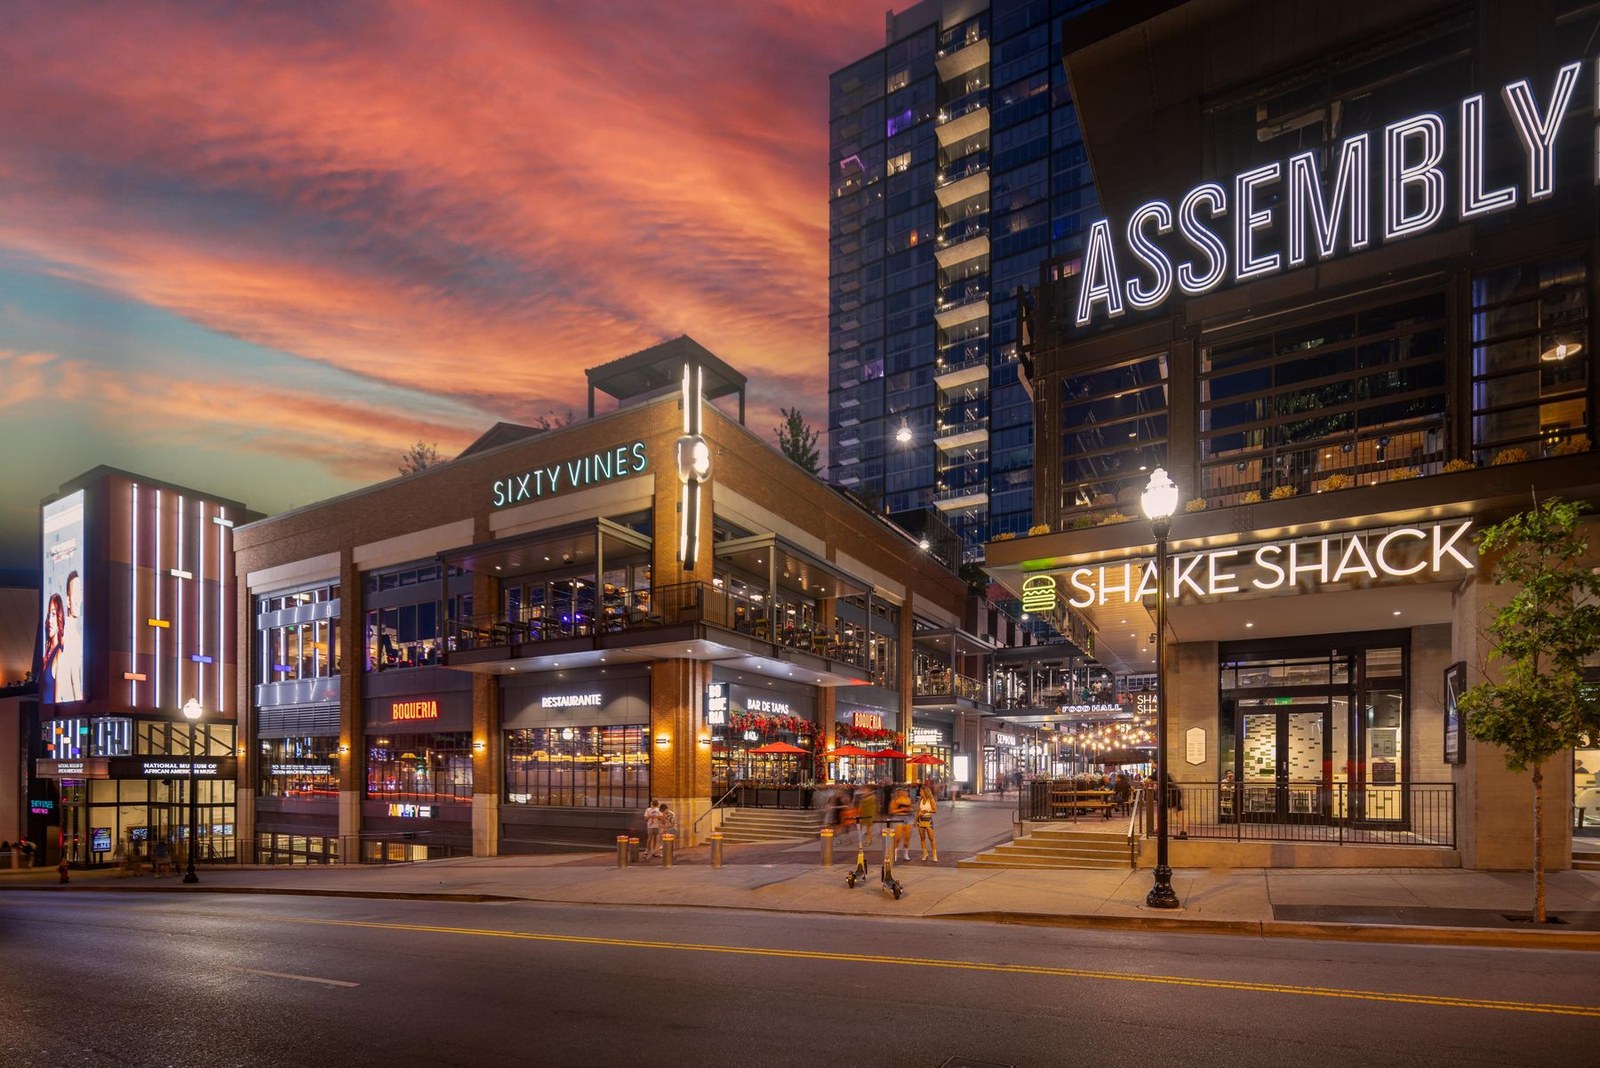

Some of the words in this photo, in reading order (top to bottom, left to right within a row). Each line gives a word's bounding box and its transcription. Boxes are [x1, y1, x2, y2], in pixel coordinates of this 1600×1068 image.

[1076, 61, 1582, 326] ASSEMBLY
[493, 464, 561, 507] SIXTY
[568, 442, 646, 487] VINES
[1069, 549, 1239, 608] SHAKE
[1252, 521, 1475, 590] SHACK
[392, 700, 438, 720] BOQUERIA
[541, 693, 602, 708] RESTAURANTE
[747, 699, 761, 711] BAR
[762, 701, 771, 712] DE
[771, 702, 790, 715] TAPAS
[1061, 705, 1091, 713] FOOD
[1091, 703, 1123, 712] HALL
